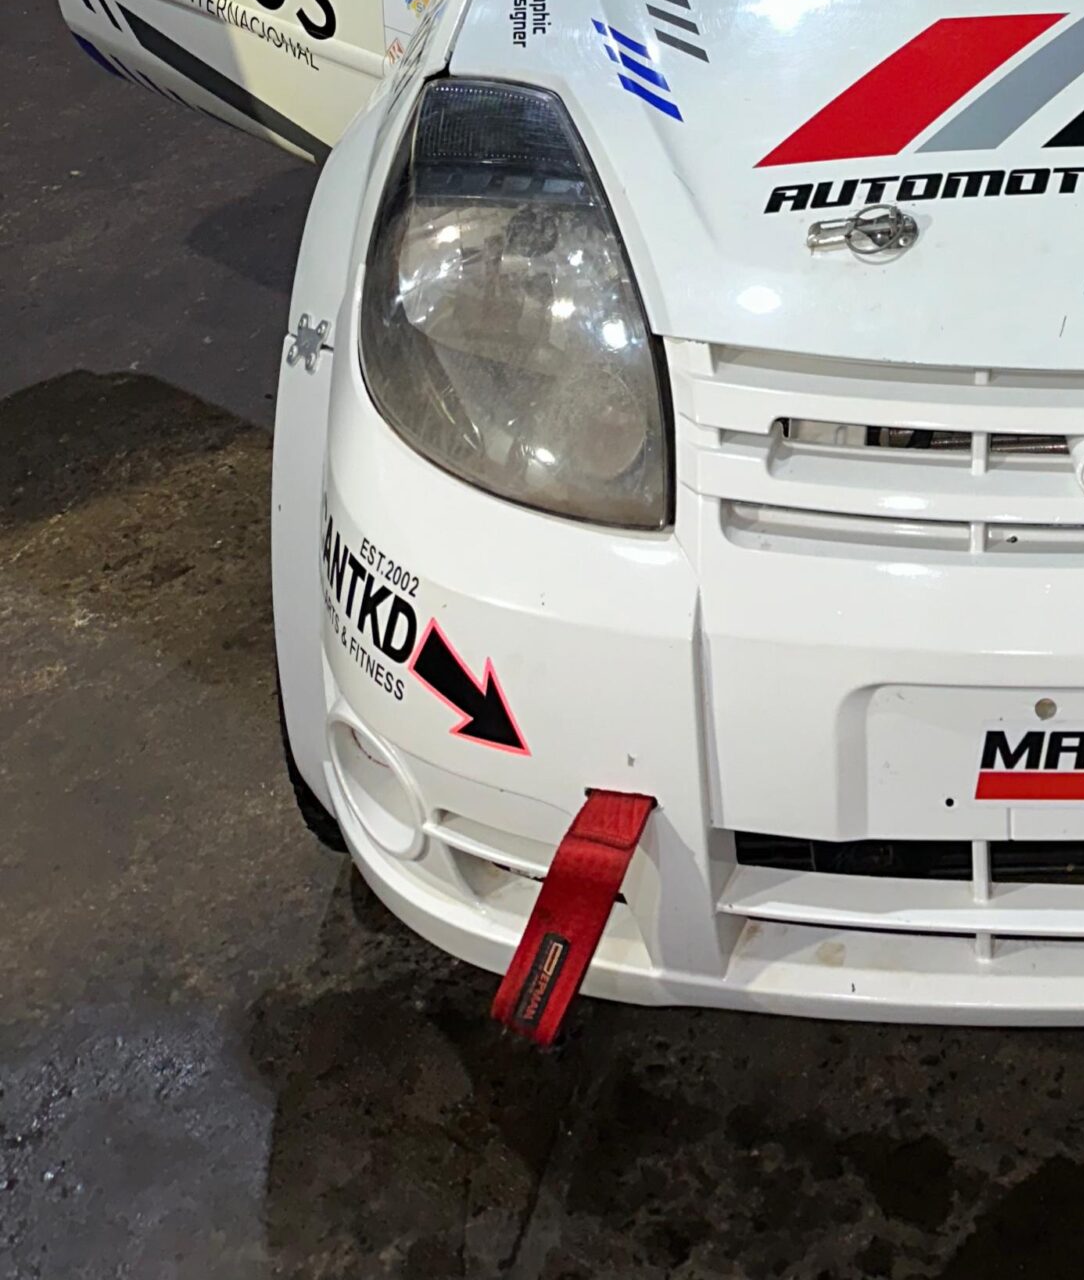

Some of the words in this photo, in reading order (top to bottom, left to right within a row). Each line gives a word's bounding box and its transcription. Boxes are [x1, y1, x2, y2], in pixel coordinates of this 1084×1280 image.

[321, 494, 418, 664] ANTKD
[360, 537, 420, 597] EST.2002
[349, 636, 405, 701] FITNESS
